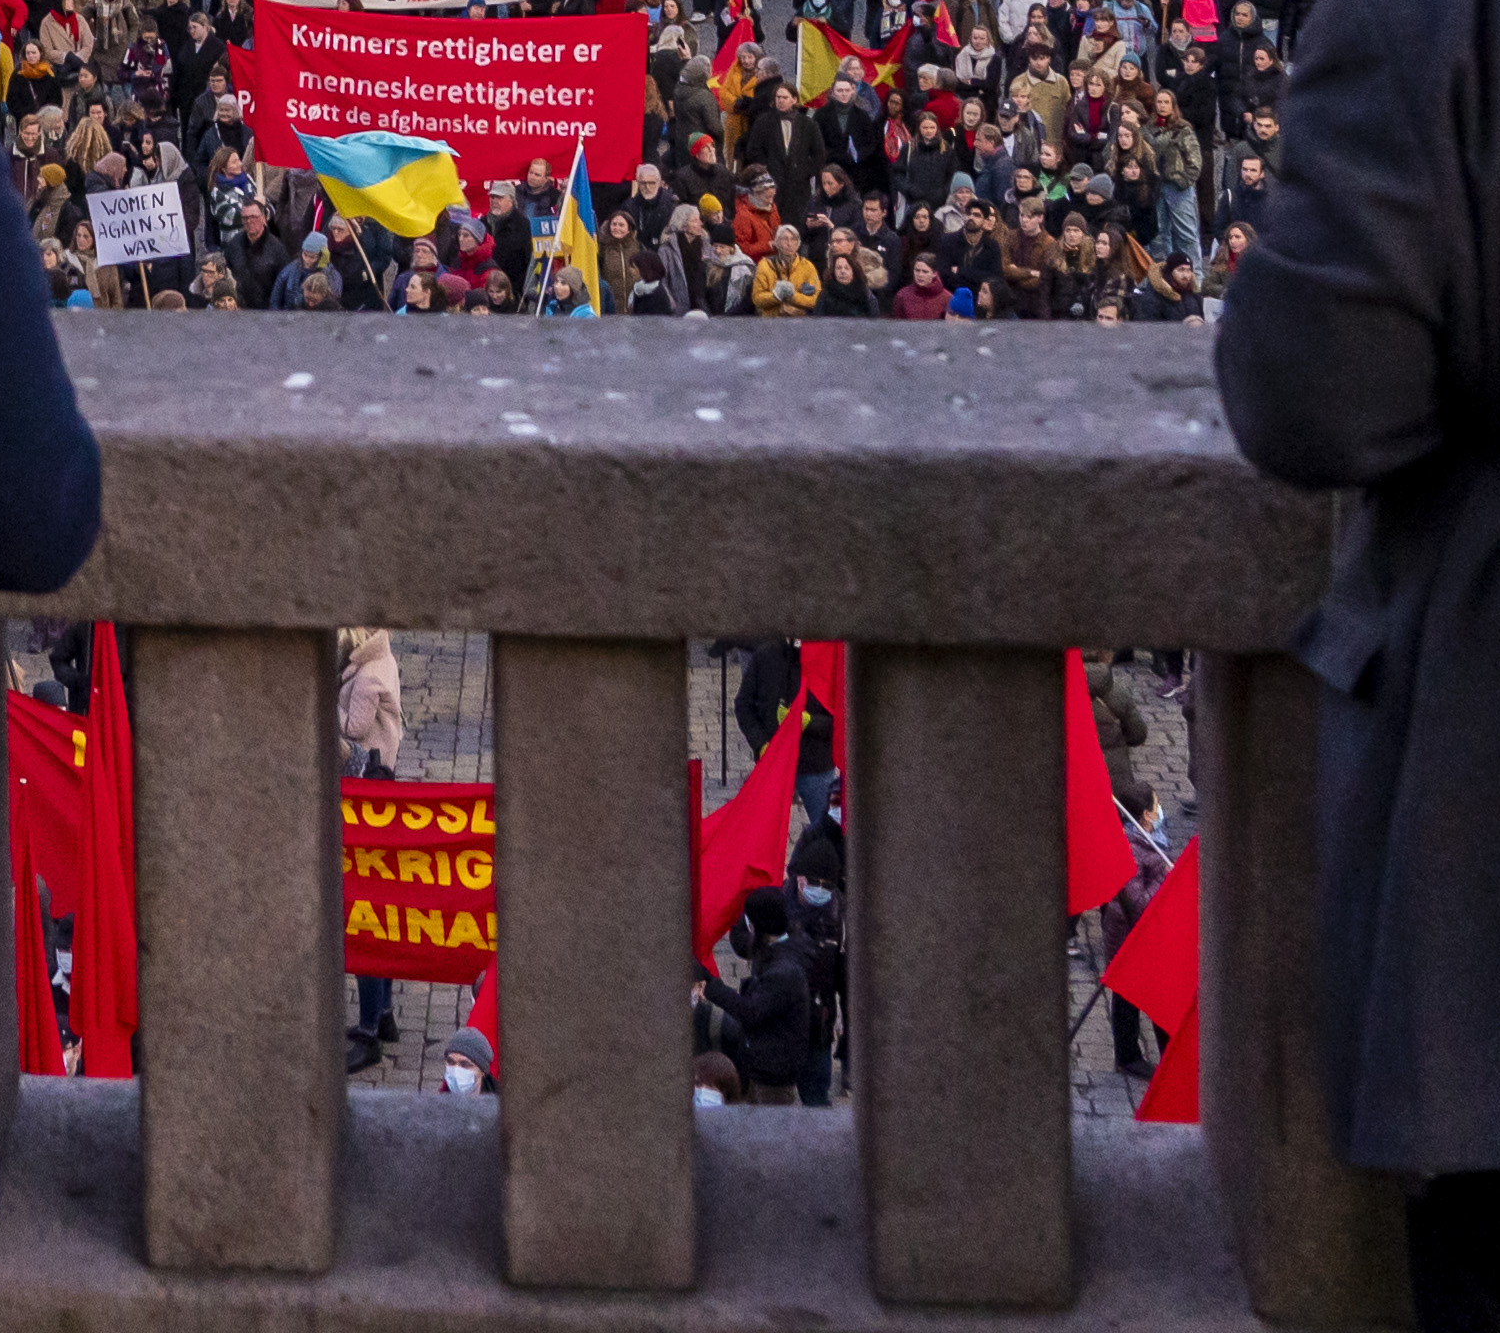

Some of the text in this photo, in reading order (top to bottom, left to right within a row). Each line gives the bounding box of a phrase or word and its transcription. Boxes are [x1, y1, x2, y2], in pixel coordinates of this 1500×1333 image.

[291, 22, 603, 67] Kvinners rettigheter er
[298, 69, 595, 111] menneskerettigheter:
[286, 98, 597, 137] Støtt de afghanske kvinnene
[100, 191, 164, 216] WOMEN
[98, 213, 179, 239] AGAINST
[123, 237, 162, 257] WAR
